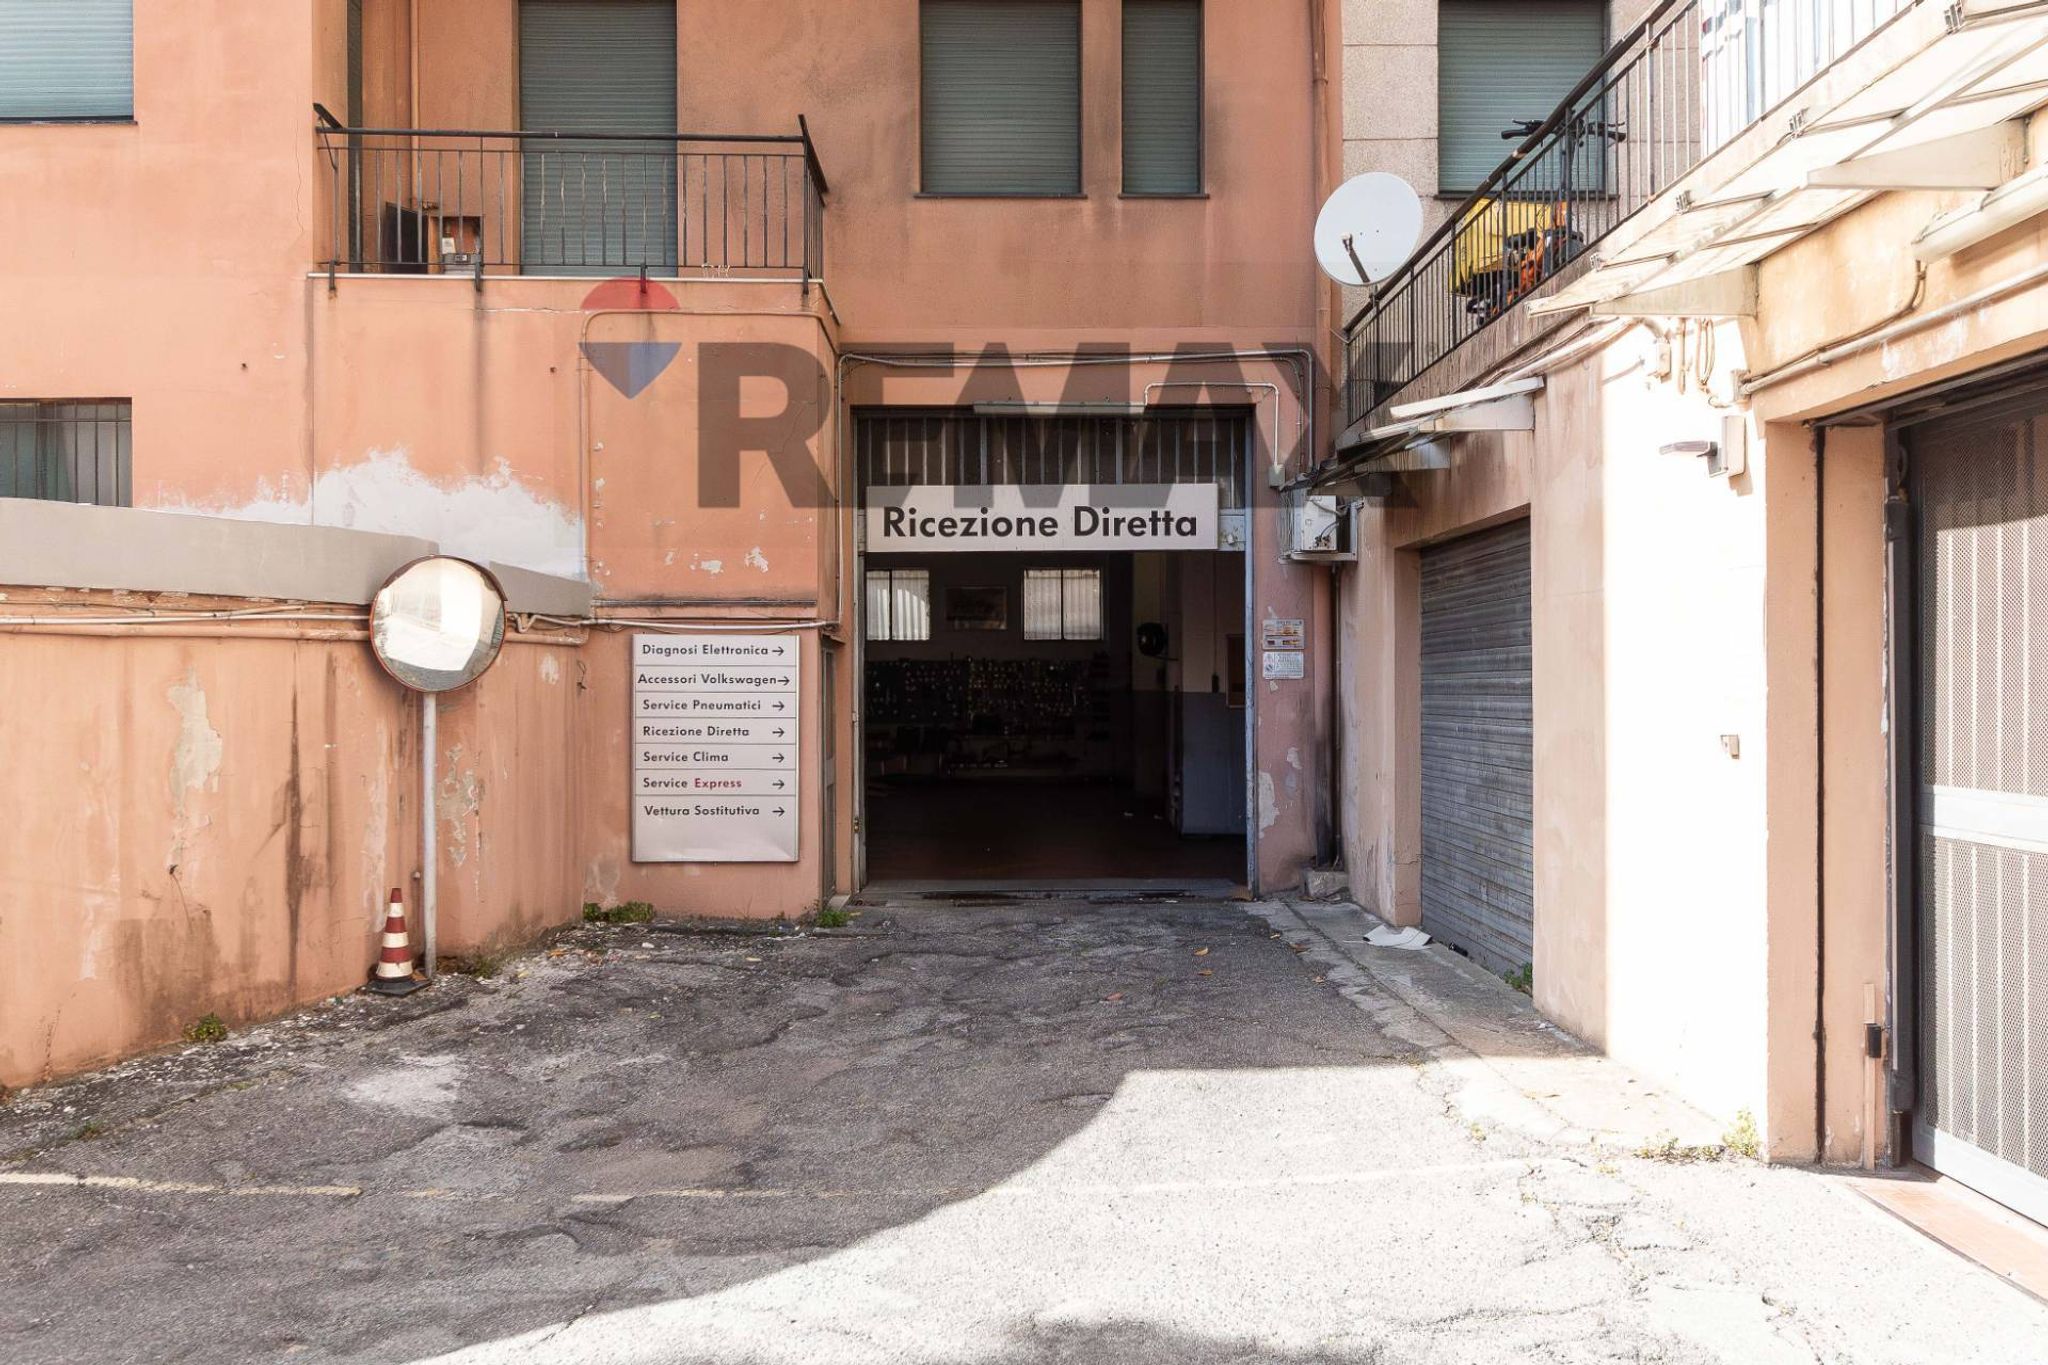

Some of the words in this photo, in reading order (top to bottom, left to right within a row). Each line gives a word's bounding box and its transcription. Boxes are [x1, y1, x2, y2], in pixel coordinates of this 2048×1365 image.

[883, 506, 1058, 538] Ricezione
[1073, 506, 1197, 538] Diretta
[642, 644, 697, 657] Diagnosi
[703, 645, 768, 655] Elettronica
[638, 674, 696, 684] Accessori
[701, 674, 776, 687] Volkswagen
[643, 700, 688, 710] Service
[693, 700, 761, 710] Pneumatici
[643, 726, 702, 736] Ricezione
[707, 726, 749, 736] Diretta
[644, 752, 688, 762] Service
[693, 751, 729, 762] Clima
[643, 778, 688, 788] Service
[694, 778, 742, 790] Express
[644, 806, 690, 816] Vettura
[694, 805, 759, 816] Sostitutiva
